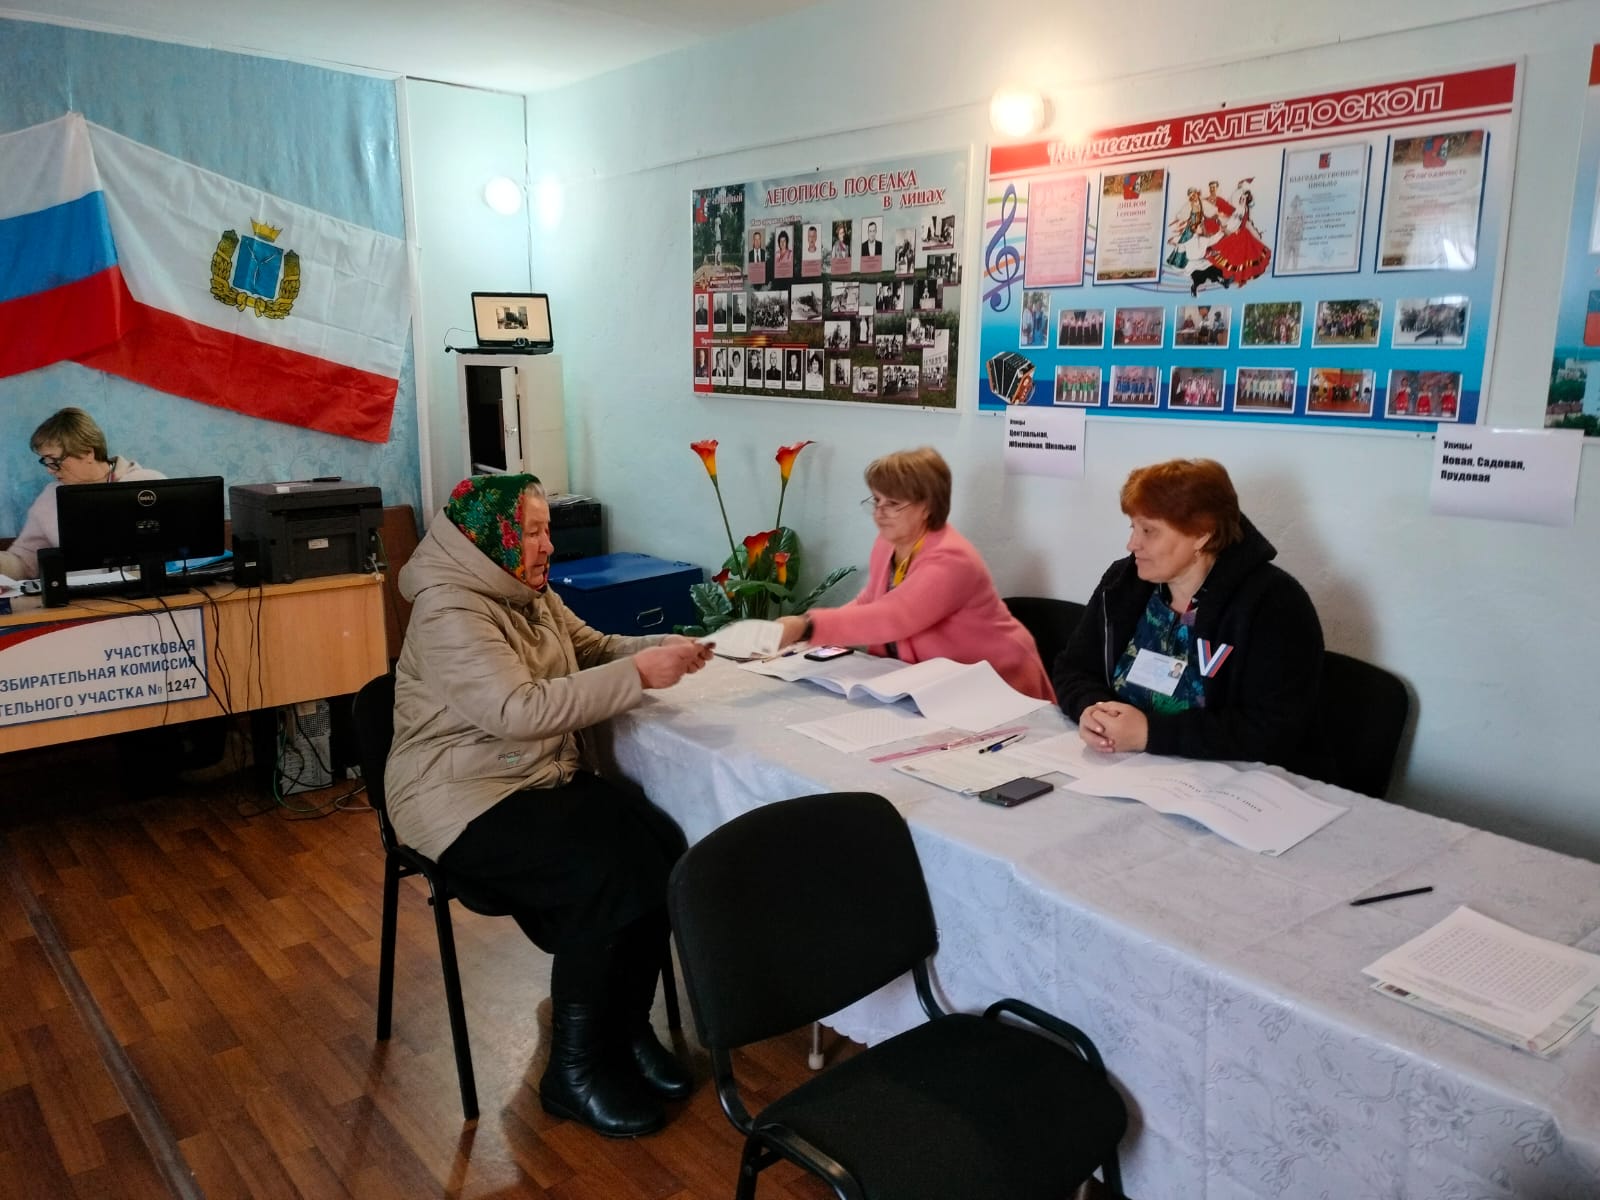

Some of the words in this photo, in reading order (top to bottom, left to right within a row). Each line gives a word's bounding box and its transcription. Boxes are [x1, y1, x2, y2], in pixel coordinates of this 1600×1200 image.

[1047, 124, 1171, 167] ческий
[1183, 82, 1444, 145] КАЛЕЙДОСКОП
[764, 181, 837, 207] ЛЕТОПИСЬ
[844, 170, 918, 196] ПОСЕЛКА
[1443, 440, 1473, 451] Улицы
[1442, 455, 1475, 467] Новая,
[1477, 457, 1526, 471] Садовая,
[1440, 469, 1491, 483] Прудовая
[104, 639, 196, 661] УЧАСТКОВАЯ
[120, 655, 197, 678] КОМИССИЯ
[78, 687, 144, 706] УЧАСТКА
[167, 677, 197, 693] 1247
